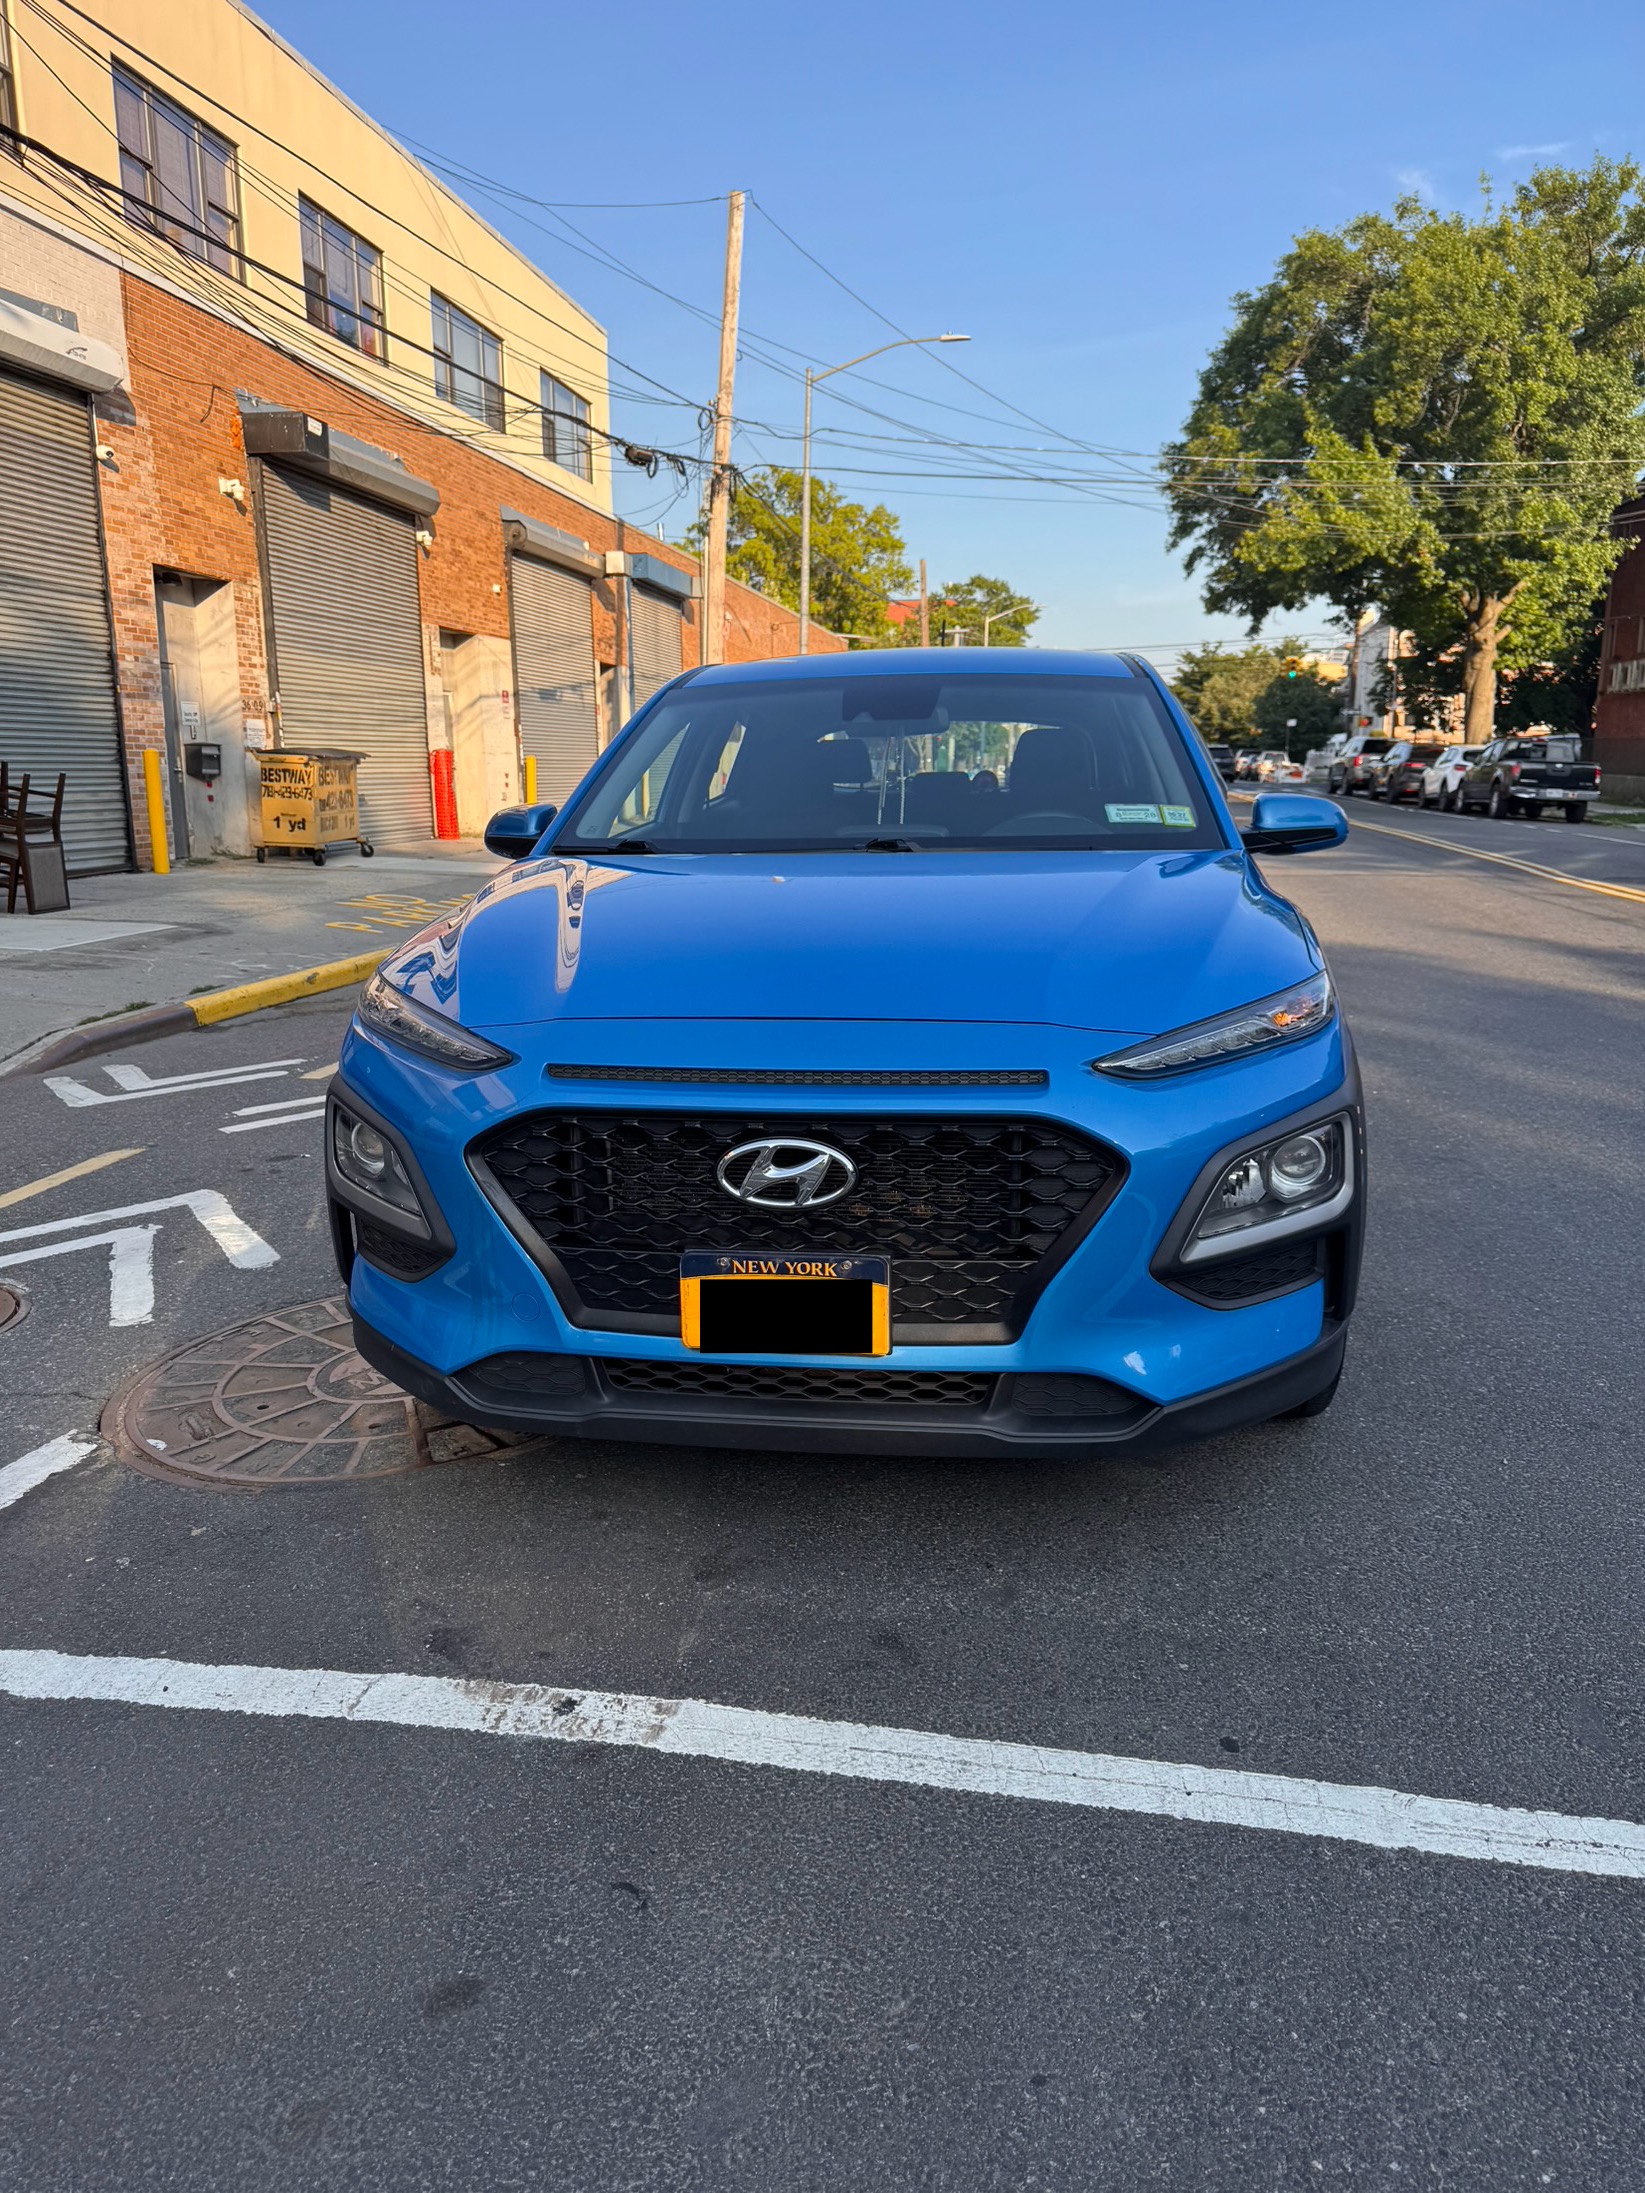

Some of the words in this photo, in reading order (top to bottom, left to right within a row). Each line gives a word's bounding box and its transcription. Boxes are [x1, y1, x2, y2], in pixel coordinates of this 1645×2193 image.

[261, 767, 312, 785] BESTWAY
[273, 816, 280, 828] 1
[288, 818, 306, 832] yd
[732, 1259, 779, 1274] NEW
[785, 1261, 837, 1277] YORK
